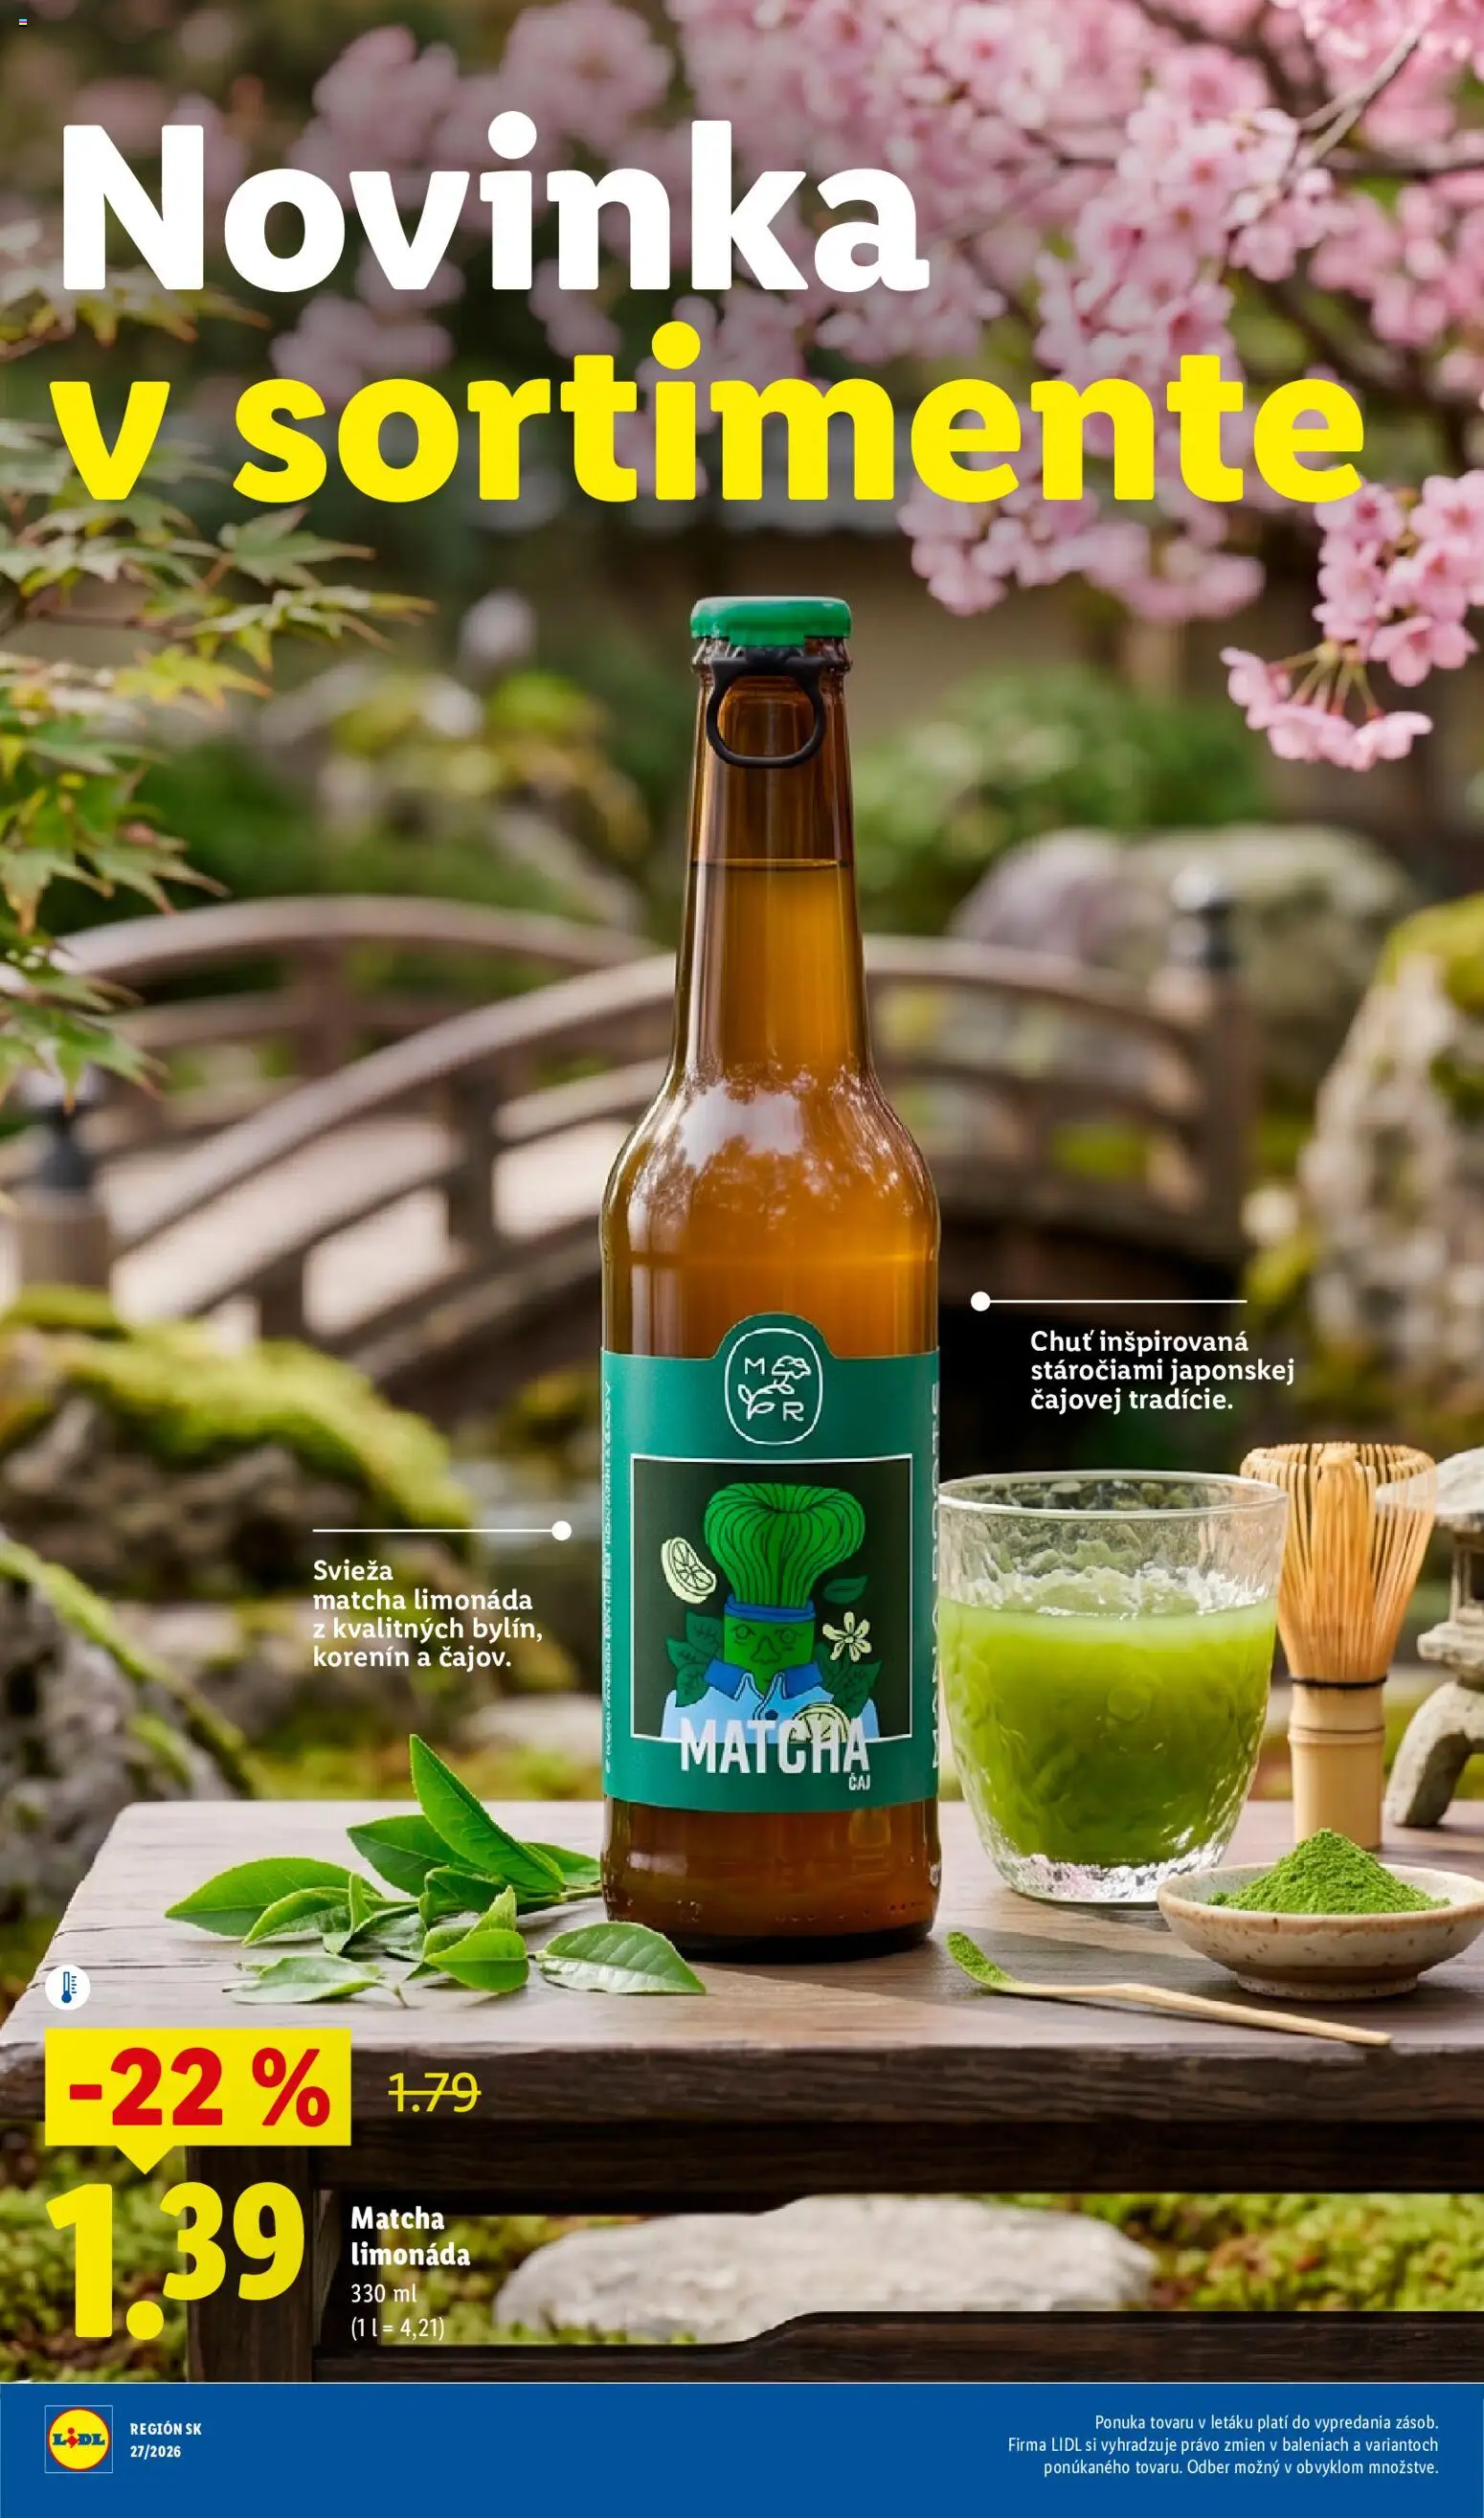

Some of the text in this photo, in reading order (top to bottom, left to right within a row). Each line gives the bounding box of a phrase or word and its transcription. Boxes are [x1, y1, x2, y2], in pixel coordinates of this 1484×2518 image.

[63, 110, 930, 293] Novinka
[49, 321, 1364, 504] v sortimente
[1030, 1329, 1249, 1358] Chuť inšpirovaná
[1031, 1358, 1294, 1386] stáročiami japonskej
[1030, 1387, 1233, 1415] čajovej tradície.
[314, 1559, 393, 1581] Svieža
[313, 1588, 533, 1610] matcha limonáda
[313, 1617, 542, 1644] z kvalitných bylín,
[314, 1645, 511, 1672] korenín a čajov.
[679, 1717, 872, 1775] MATCHA
[848, 1772, 870, 1790] ČAJ
[69, 2047, 330, 2127] -22 %
[388, 2072, 482, 2113] 1.79
[351, 2205, 445, 2230] Matcha
[45, 2182, 304, 2341] 1.39
[351, 2240, 471, 2266] limonáda
[351, 2283, 416, 2304] 330 ml
[351, 2317, 365, 2341] (1
[372, 2318, 377, 2337] l
[400, 2317, 444, 2341] 4,21)
[129, 2420, 202, 2436] REGIÓN SK
[1095, 2414, 1439, 2433] Ponuka tovaru v letáku platí do vypredania zásob.
[130, 2443, 182, 2461] 27/2026
[1008, 2437, 1438, 2456] Firma LIDL si vyhradzuje právo zmien v baleniach a variantoch
[1044, 2459, 1439, 2478] ponúkaného tovaru. Odber možný v obvyklom množstve.
